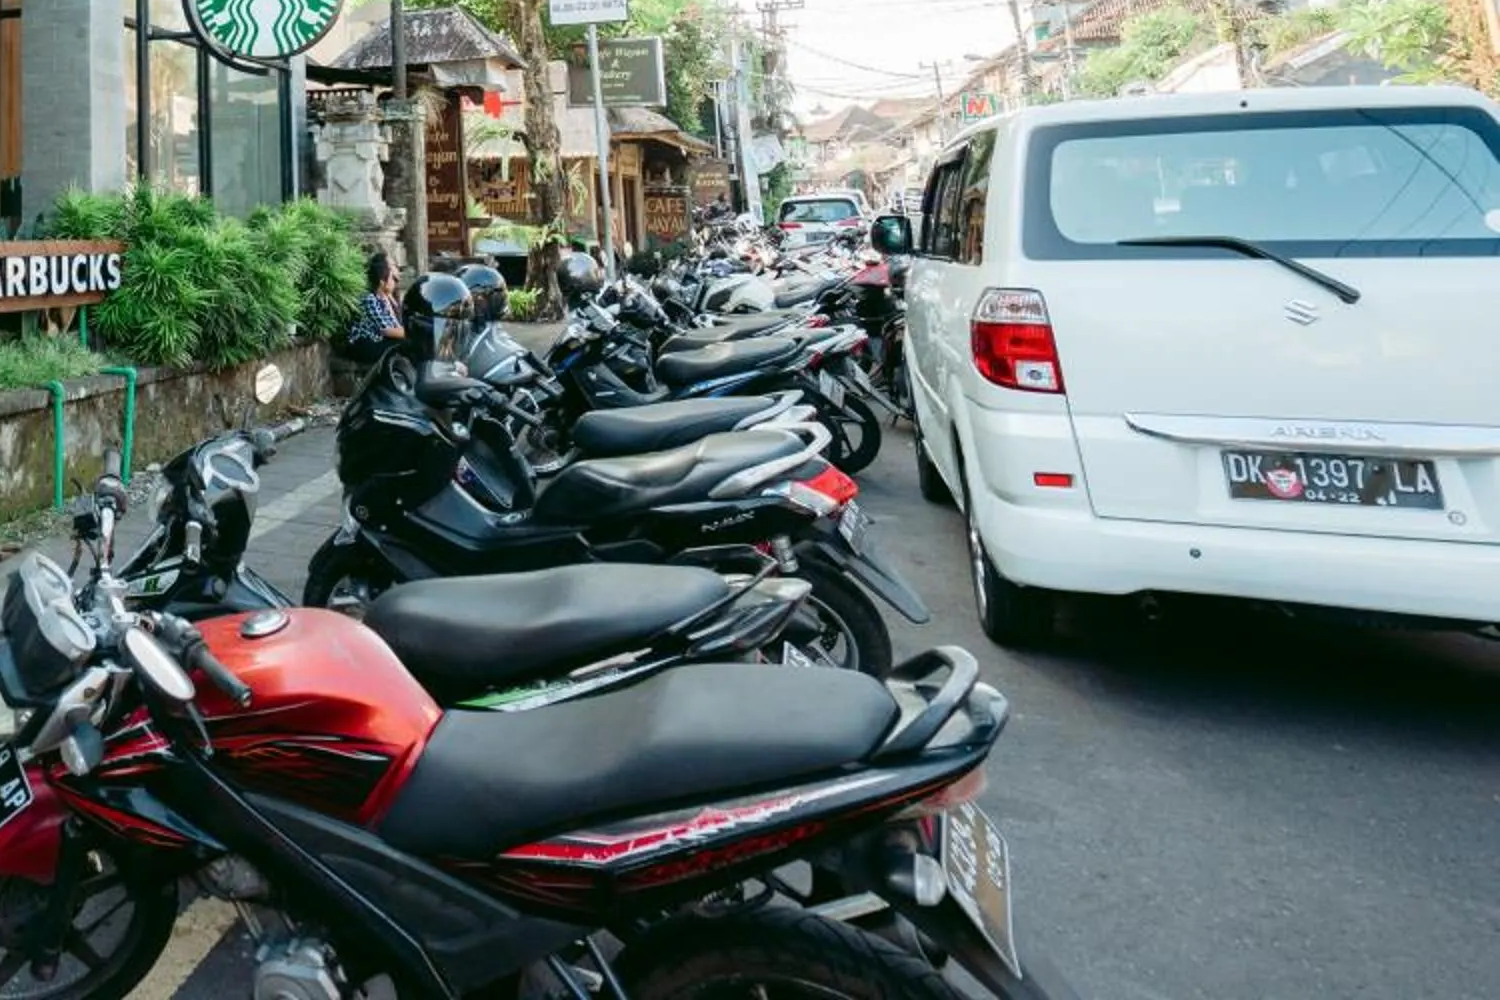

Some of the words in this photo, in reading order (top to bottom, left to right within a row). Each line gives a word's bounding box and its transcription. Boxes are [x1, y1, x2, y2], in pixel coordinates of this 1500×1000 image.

[1227, 454, 1267, 484] DK
[1296, 457, 1366, 489] 1397
[1393, 463, 1436, 494] LA
[0, 778, 27, 808] AP
